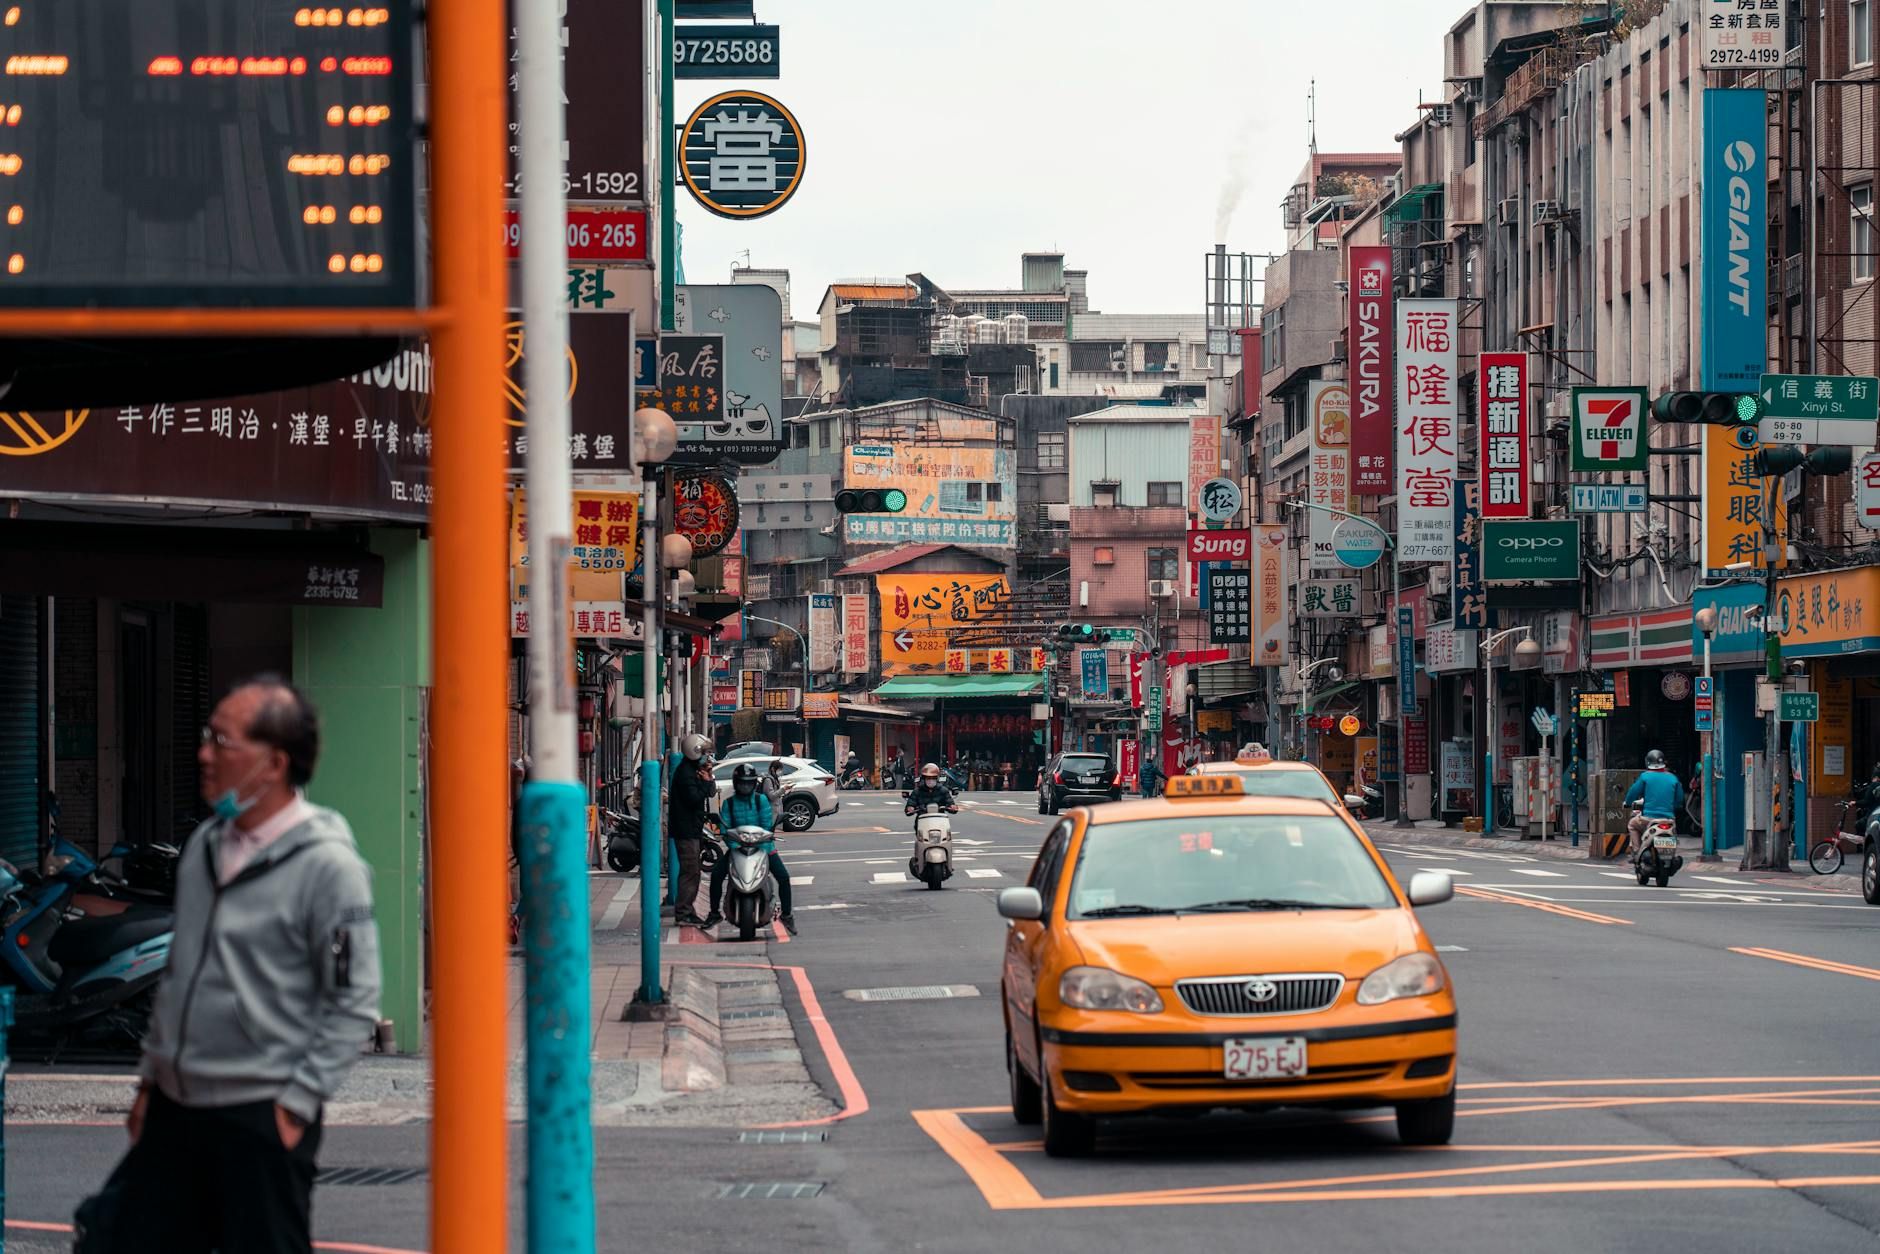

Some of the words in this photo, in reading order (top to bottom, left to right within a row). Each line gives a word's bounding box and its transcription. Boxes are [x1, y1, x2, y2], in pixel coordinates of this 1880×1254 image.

[1709, 14, 1780, 29] 全新套房
[1718, 32, 1772, 45] 出租
[1710, 49, 1780, 63] 2972-4199
[1728, 176, 1751, 317] GIANT
[1359, 301, 1381, 419] SAKURA
[1780, 379, 1868, 400] 信義街
[1403, 311, 1454, 508] 福隆便當
[1801, 402, 1828, 414] Xinyi
[1831, 402, 1845, 412] St.
[1487, 366, 1521, 505] 捷新通訊
[1773, 432, 1802, 440] 49-79
[1774, 422, 1802, 430] 50-80
[1359, 456, 1385, 468] 櫻花
[1313, 455, 1329, 504] 毛孩子
[1330, 455, 1345, 521] 動物醫院
[1600, 488, 1619, 508] ATM
[1338, 530, 1379, 538] SAKURA
[1345, 539, 1374, 547] WATER
[1192, 536, 1246, 557] Sung
[1264, 558, 1278, 614] 公益彩券
[1303, 584, 1356, 612] 獸醫
[1229, 1046, 1303, 1073] 275-EJ
